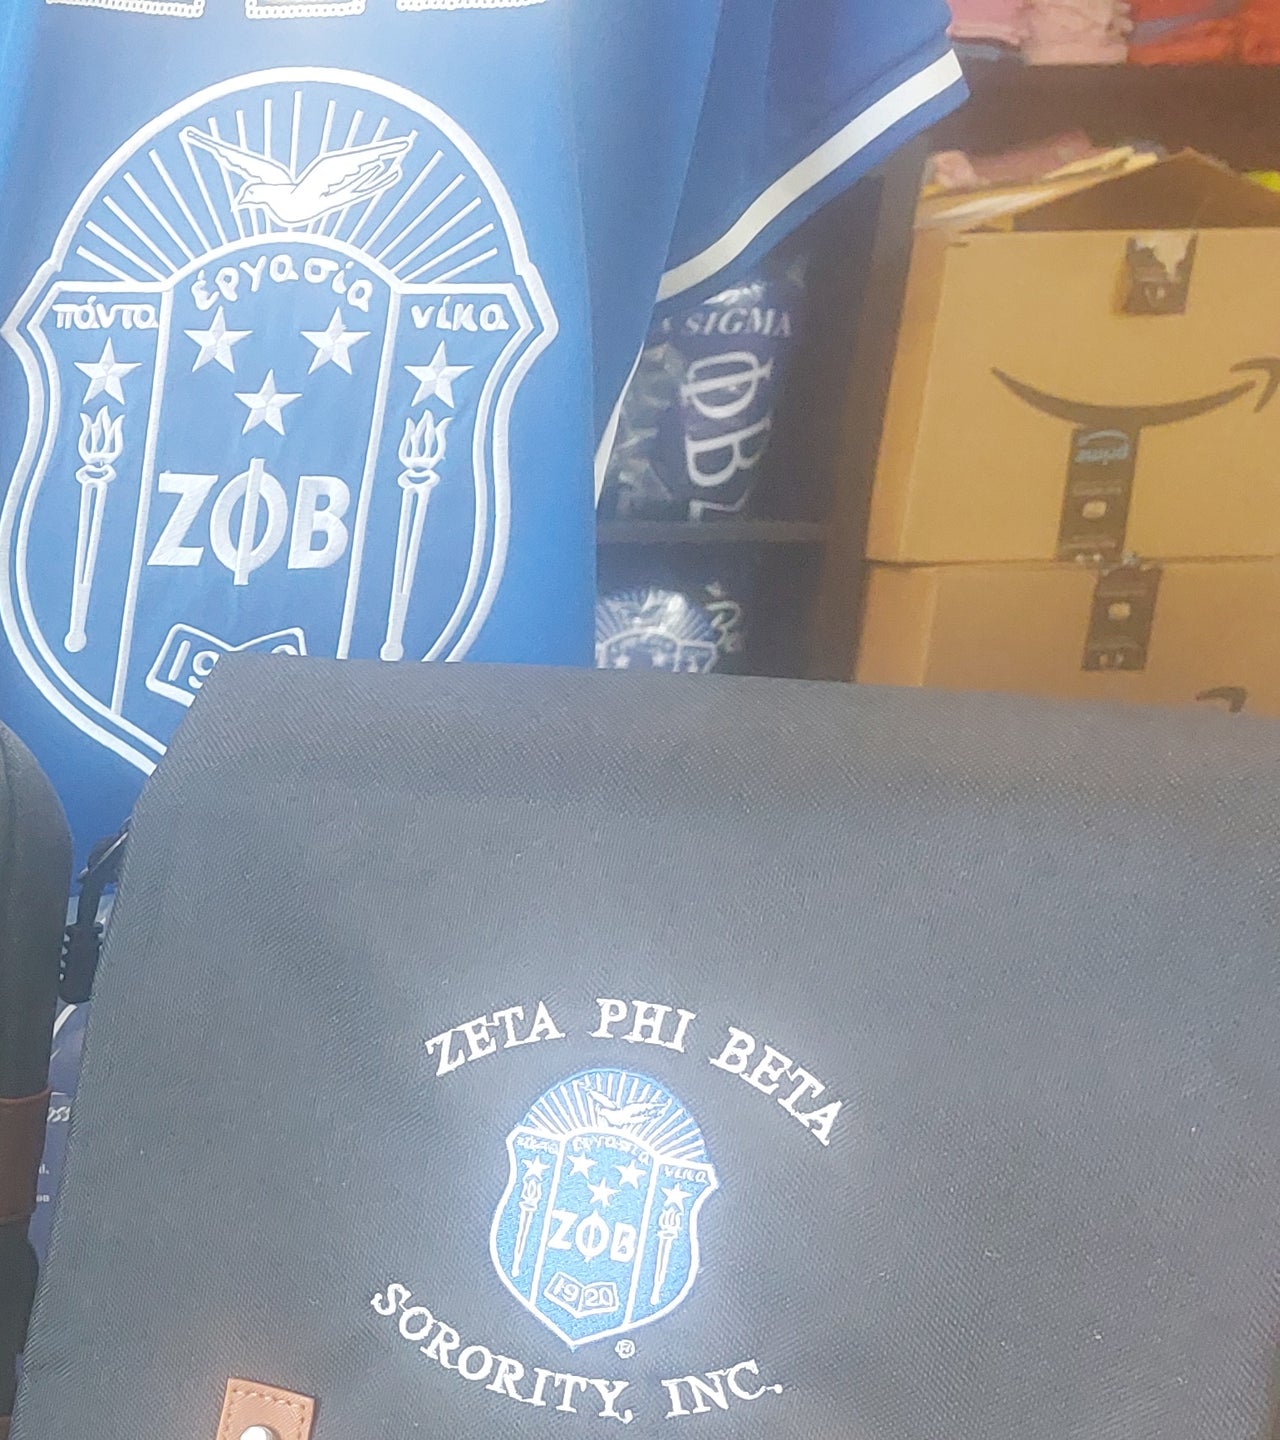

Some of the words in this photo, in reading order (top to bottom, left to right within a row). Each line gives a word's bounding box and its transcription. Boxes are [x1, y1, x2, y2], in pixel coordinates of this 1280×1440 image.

[685, 307, 792, 337] SIGMA
[681, 350, 773, 520] ΦΒ
[146, 457, 350, 586] ΖΦΒ
[425, 1001, 566, 1077] ZETA
[587, 999, 697, 1052] PHI
[710, 1026, 844, 1146] BETA
[370, 1283, 633, 1424] SORORITY,
[662, 1360, 784, 1418] INC.
[552, 1278, 614, 1308] 1920
